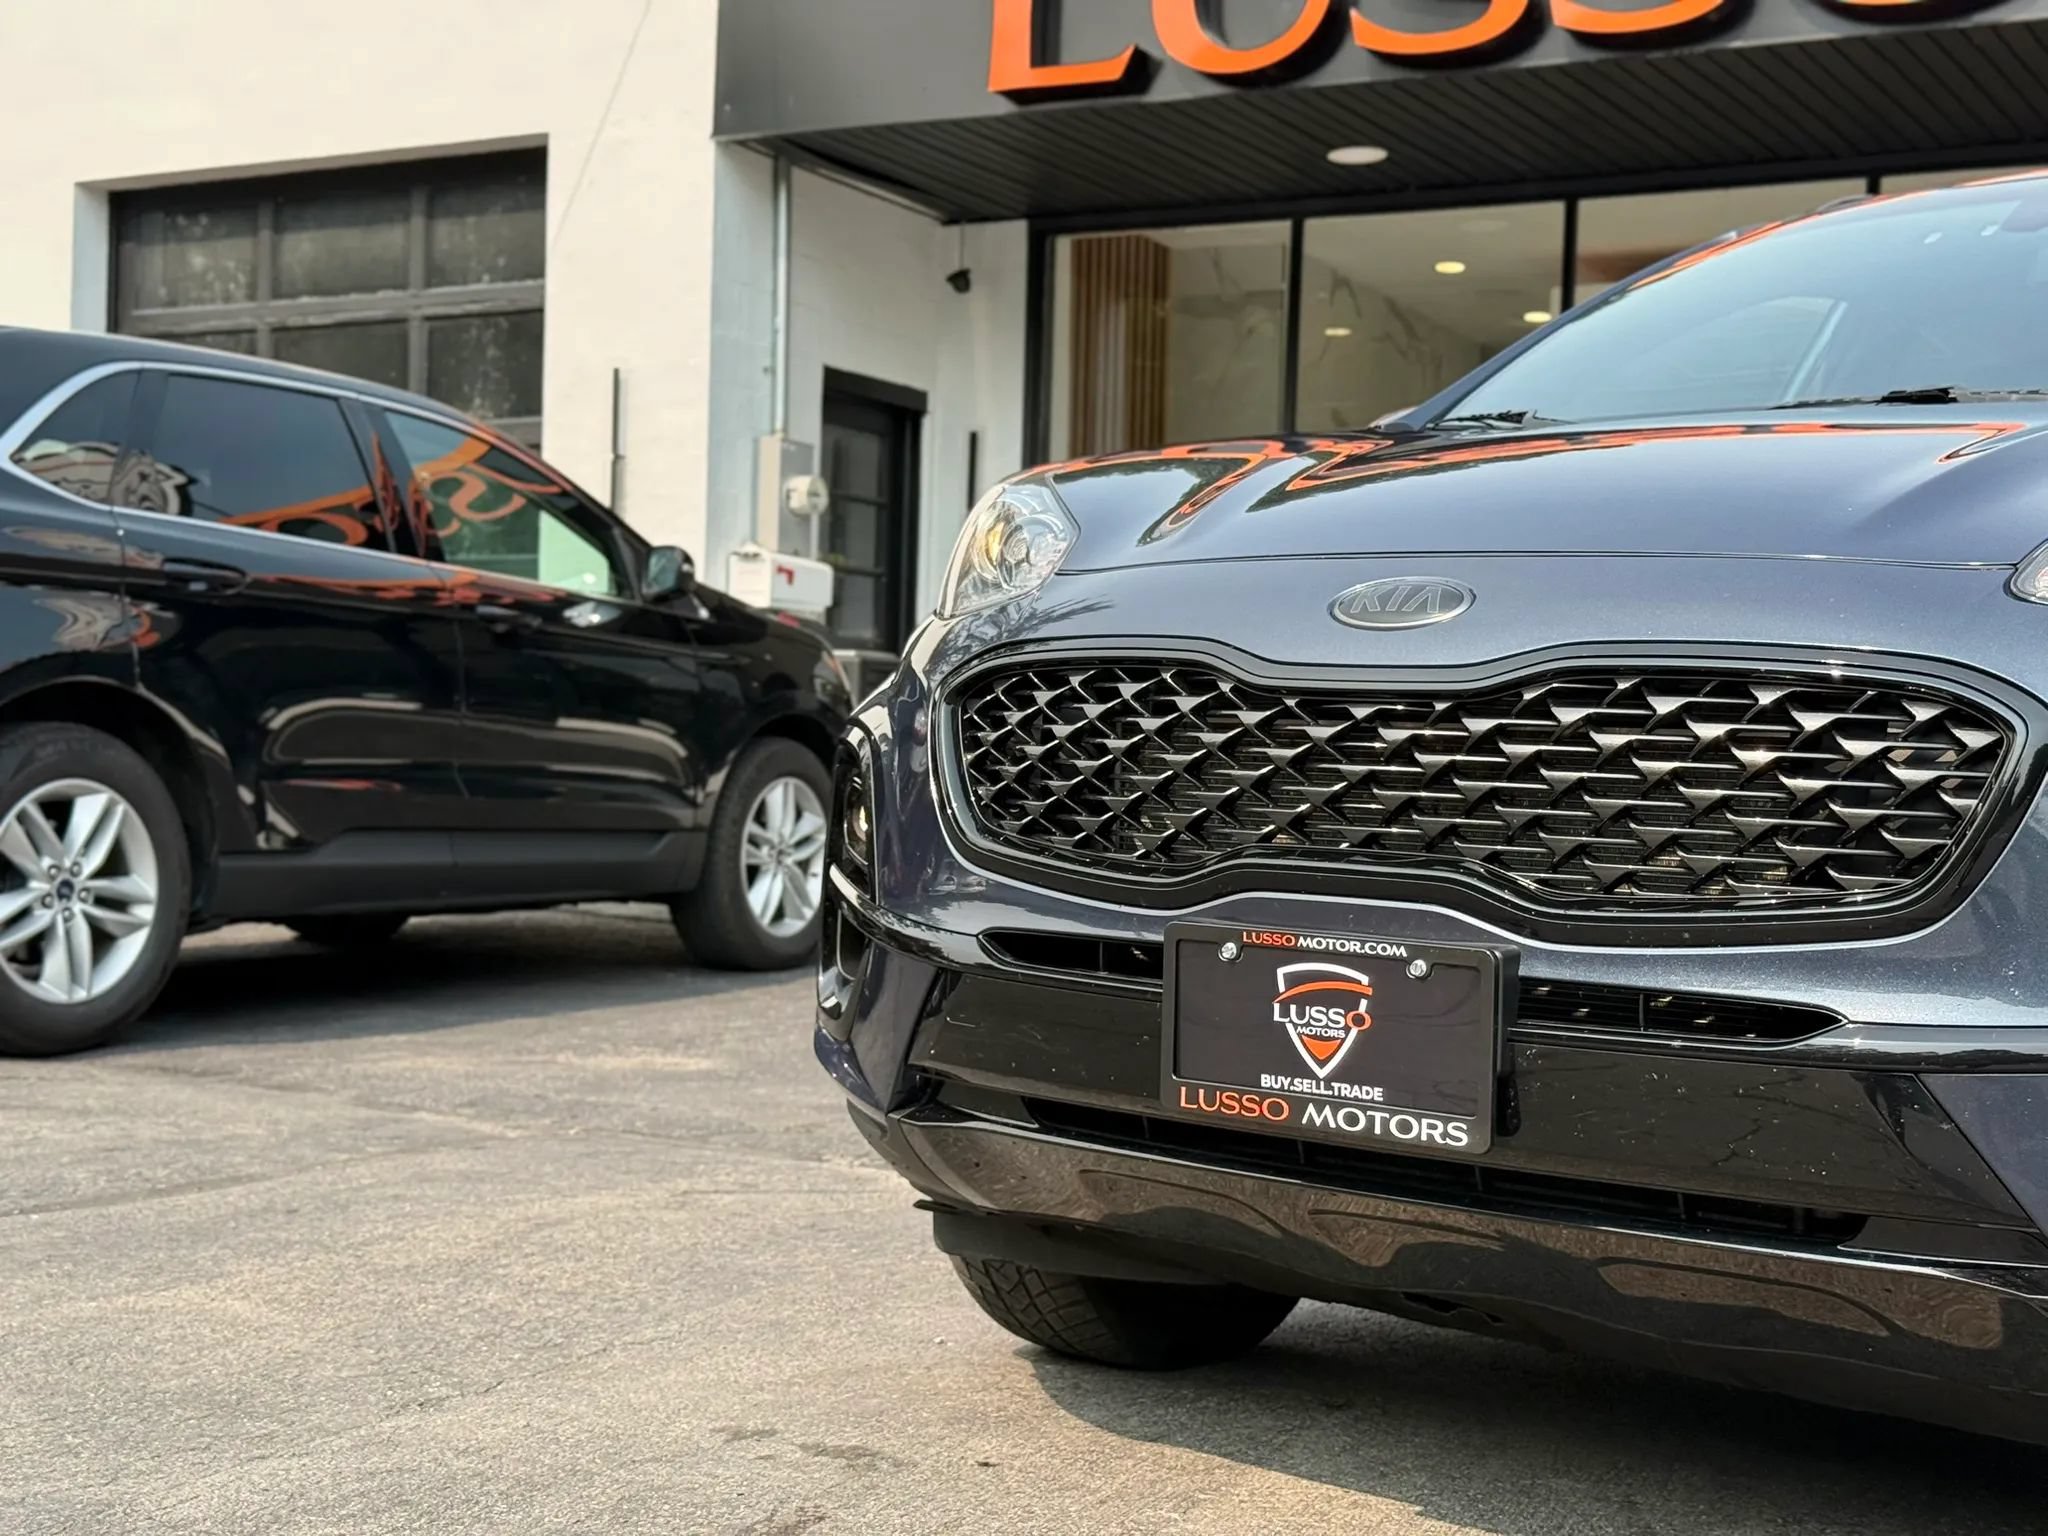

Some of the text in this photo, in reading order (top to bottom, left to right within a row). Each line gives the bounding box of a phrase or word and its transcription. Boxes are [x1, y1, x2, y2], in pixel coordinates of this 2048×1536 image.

[1350, 584, 1442, 614] KIA
[1273, 1002, 1372, 1031] LUSSO
[1296, 1026, 1346, 1039] MOTORS
[1179, 1086, 1469, 1147] LUSSO MOTORS
